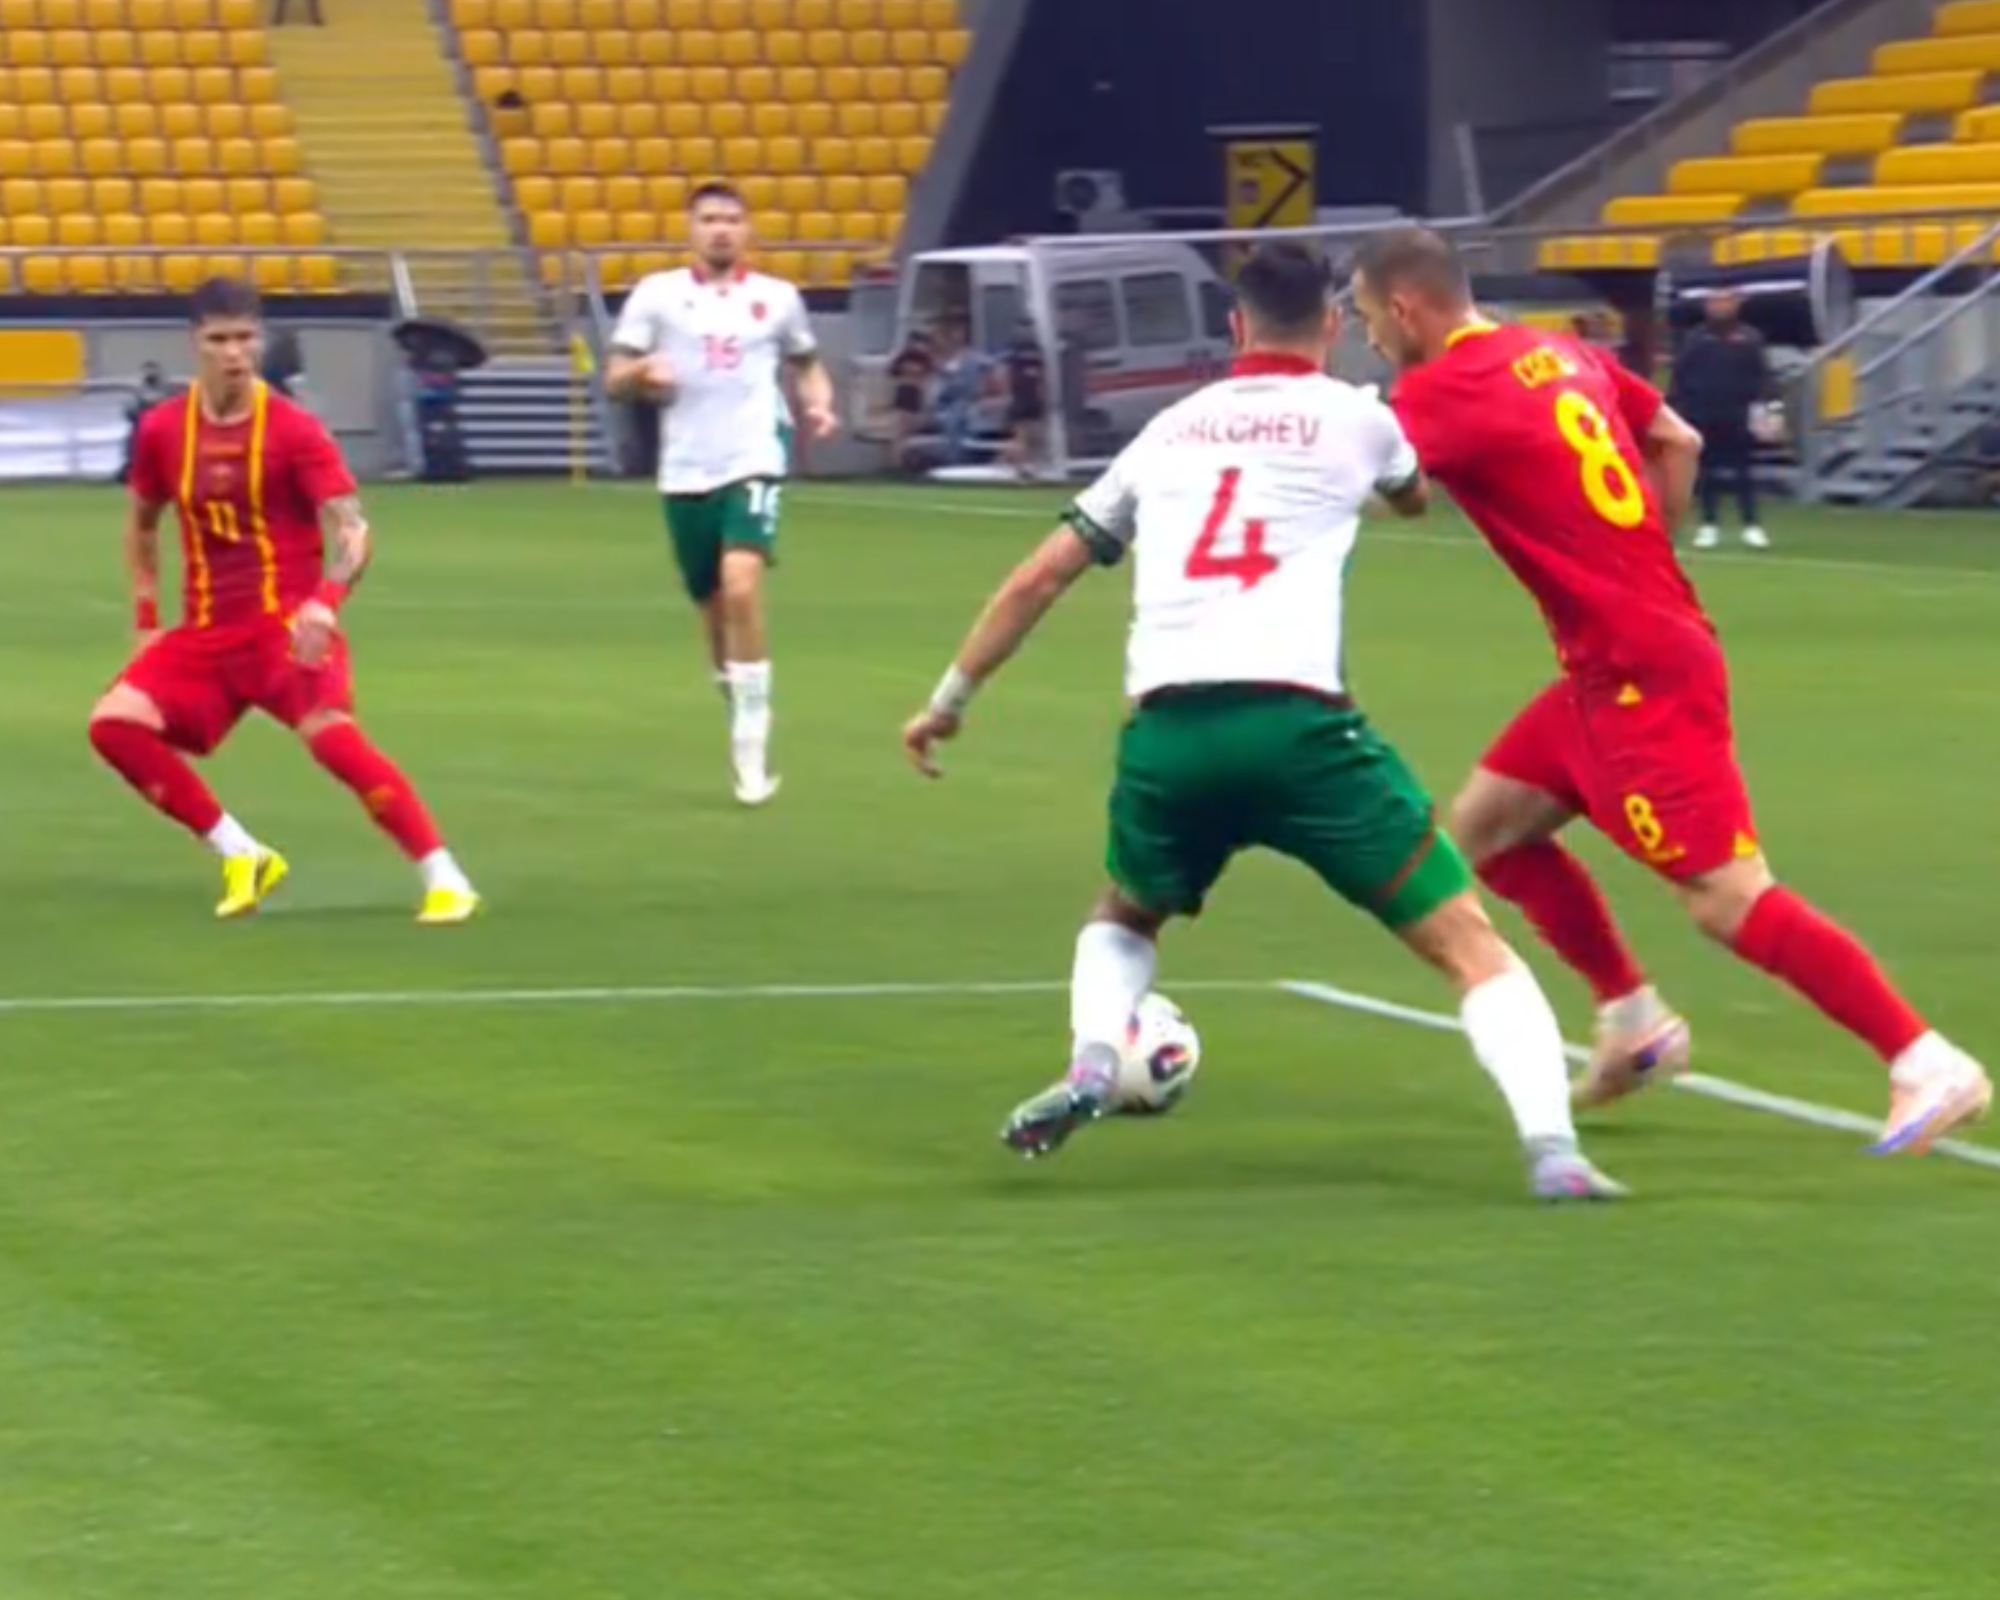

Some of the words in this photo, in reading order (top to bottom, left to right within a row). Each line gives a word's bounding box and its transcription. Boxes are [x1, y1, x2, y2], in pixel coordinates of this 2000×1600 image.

[702, 333, 744, 369] 16
[1555, 390, 1644, 528] 8
[1185, 466, 1281, 592] 4
[1624, 795, 1663, 850] 8
